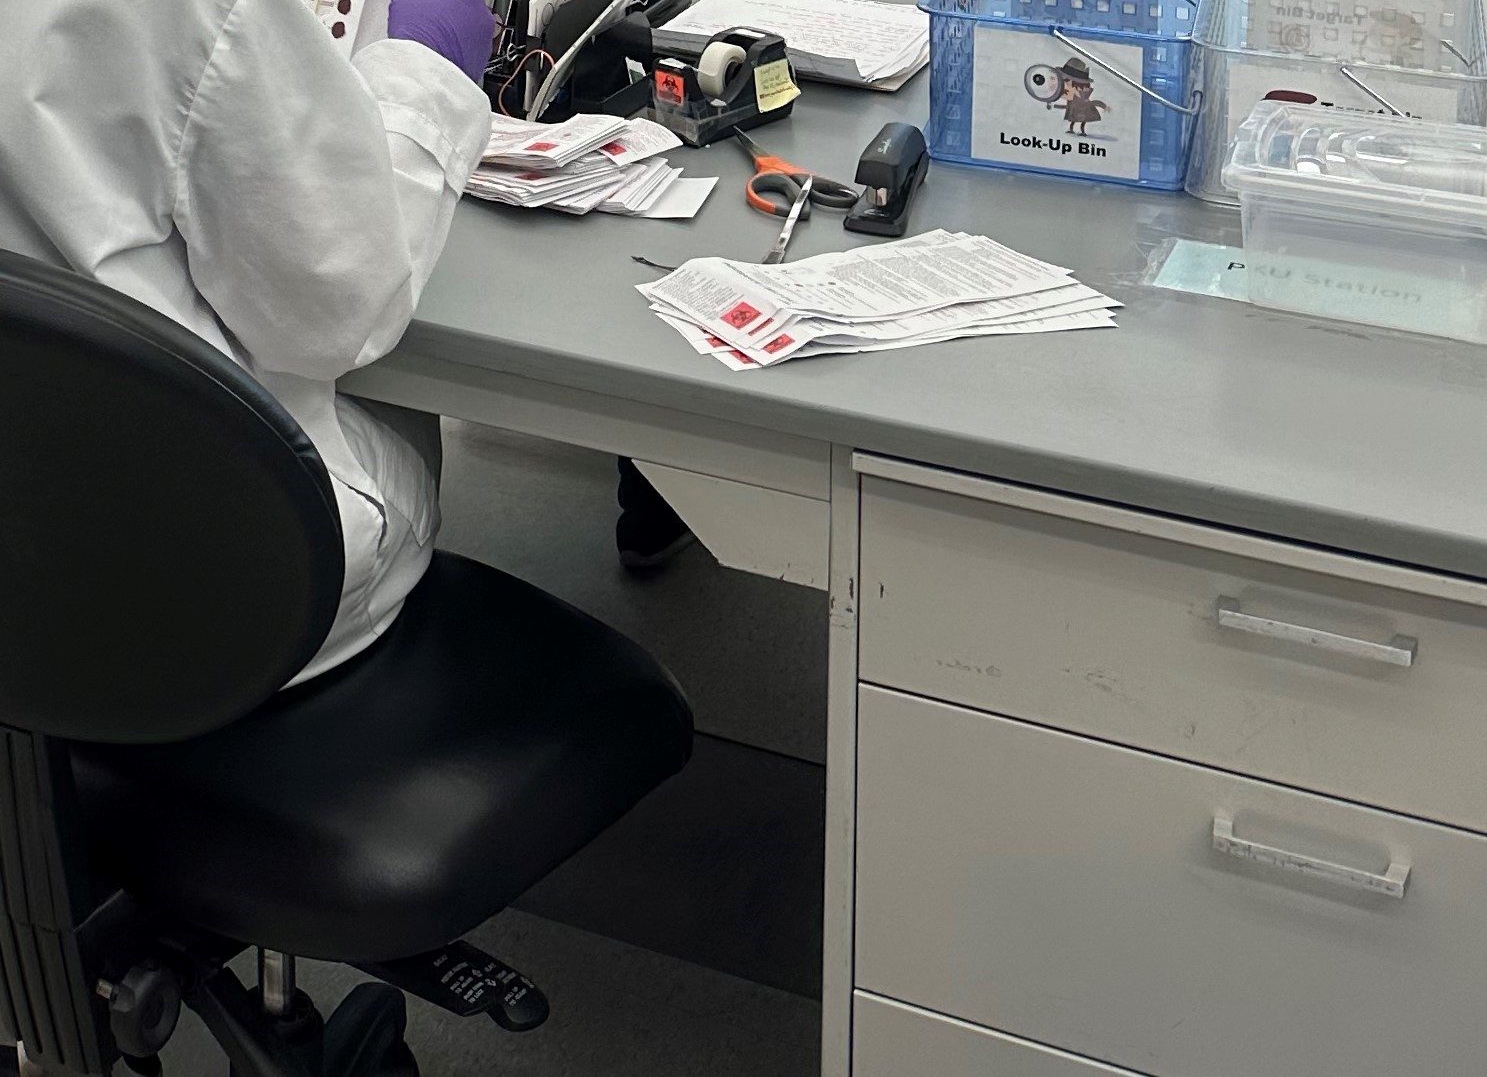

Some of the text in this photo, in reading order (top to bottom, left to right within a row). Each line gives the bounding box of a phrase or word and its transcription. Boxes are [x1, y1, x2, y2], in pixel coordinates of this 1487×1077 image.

[1000, 131, 1106, 157] Look-Up Bin
[1303, 274, 1423, 304] Station
